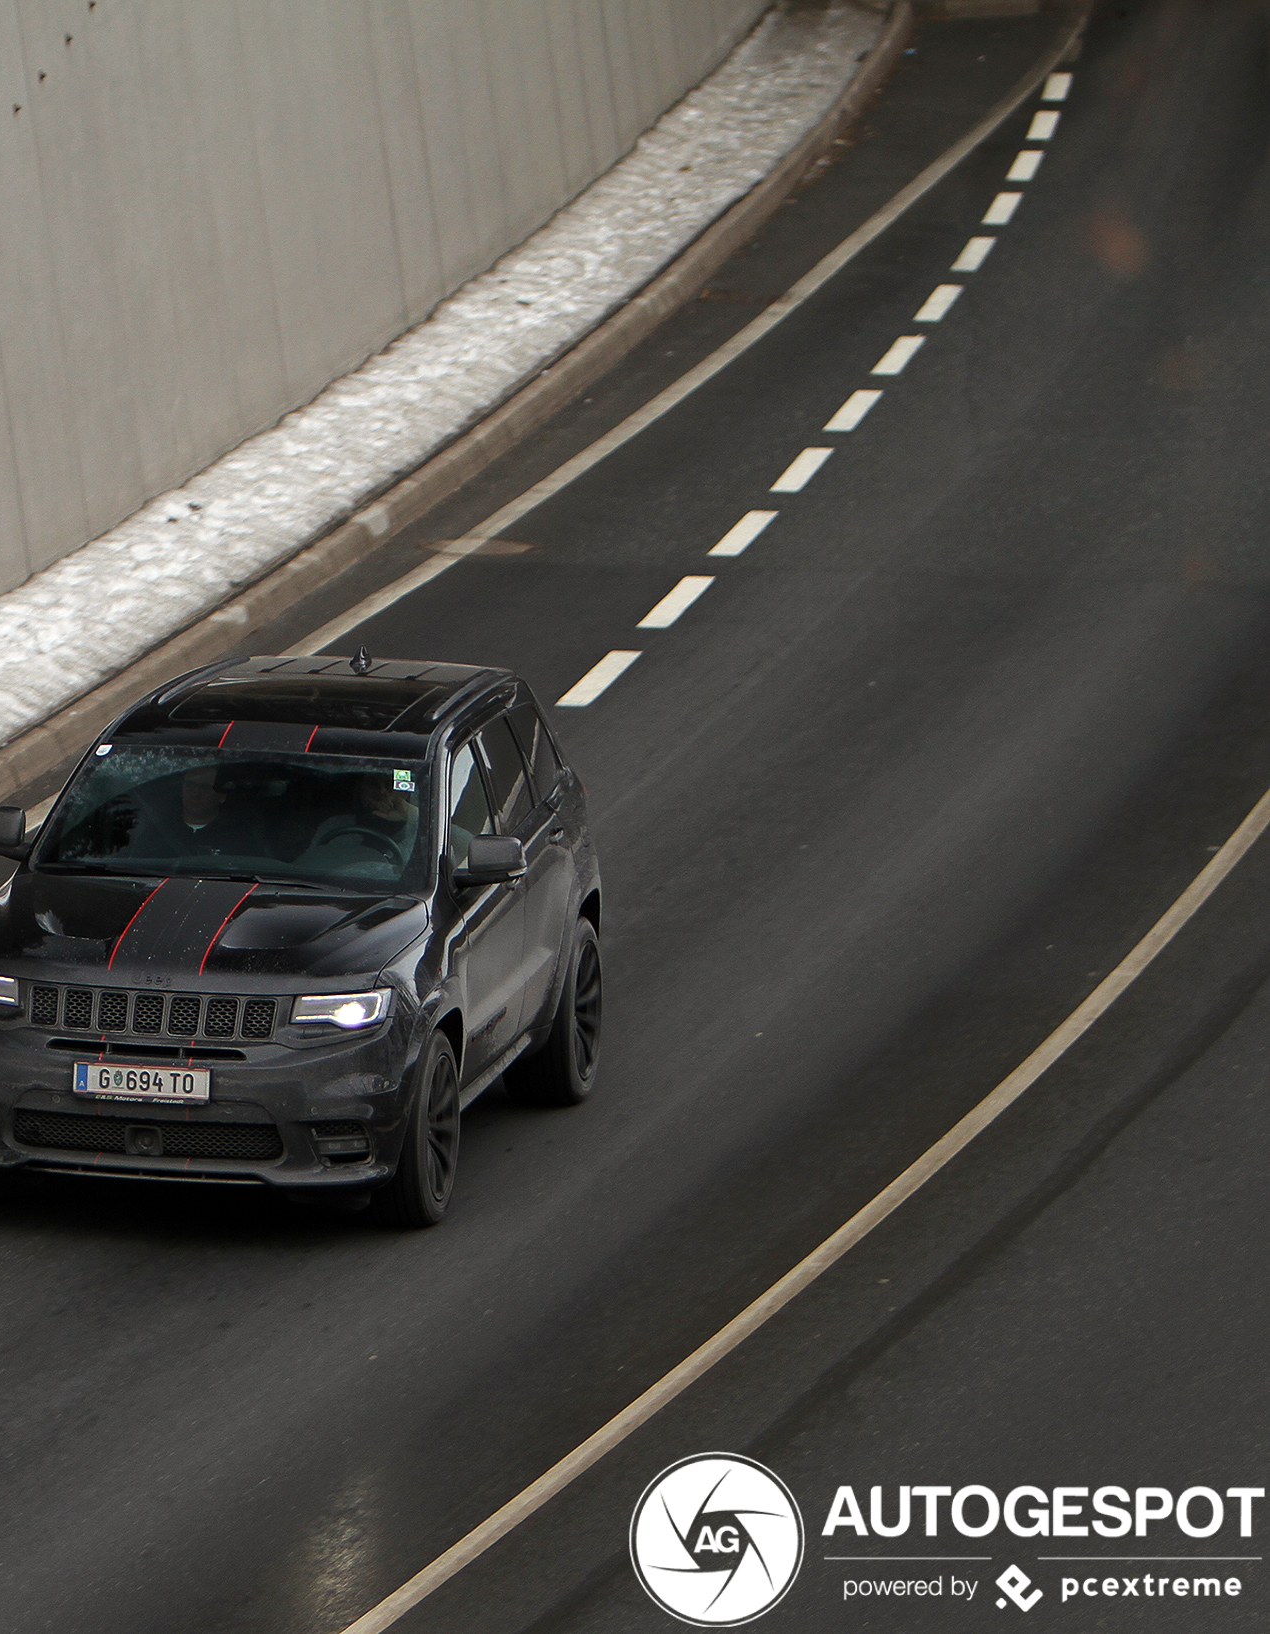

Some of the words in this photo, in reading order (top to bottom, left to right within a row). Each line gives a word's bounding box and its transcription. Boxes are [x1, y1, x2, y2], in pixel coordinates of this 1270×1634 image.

[132, 970, 173, 988] Jeep
[99, 1068, 110, 1089] G
[126, 1070, 163, 1092] 694
